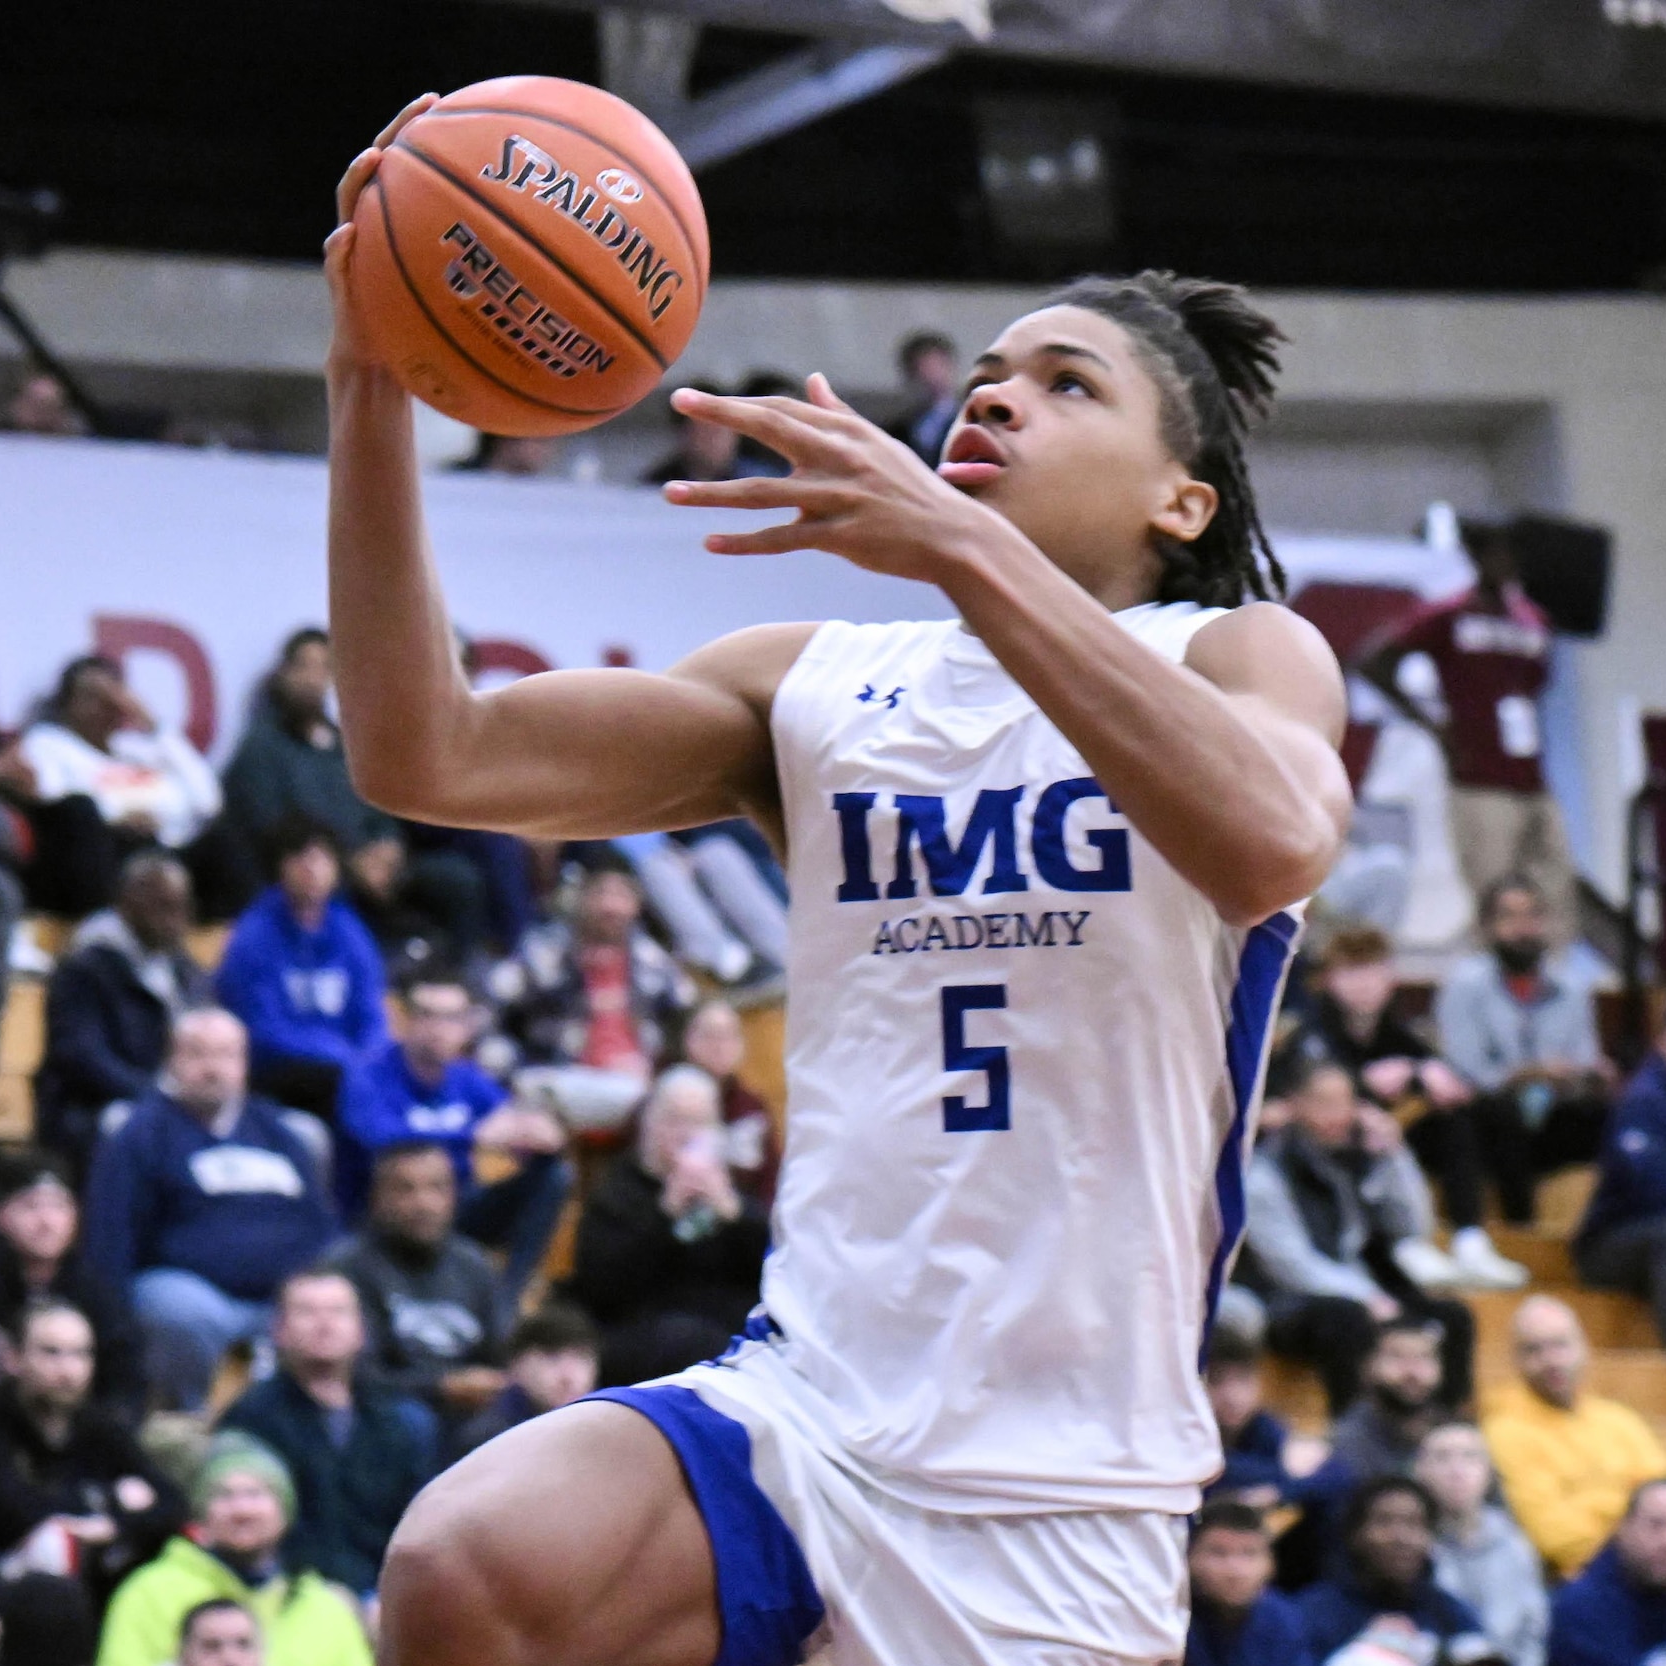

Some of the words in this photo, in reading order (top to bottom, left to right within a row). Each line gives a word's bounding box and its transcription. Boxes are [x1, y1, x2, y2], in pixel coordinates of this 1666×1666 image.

[440, 220, 615, 374] PRECISION
[478, 134, 683, 325] SPALDING
[832, 776, 1132, 902] IMG
[871, 911, 1091, 955] ACADEMY
[941, 983, 1012, 1133] 5
